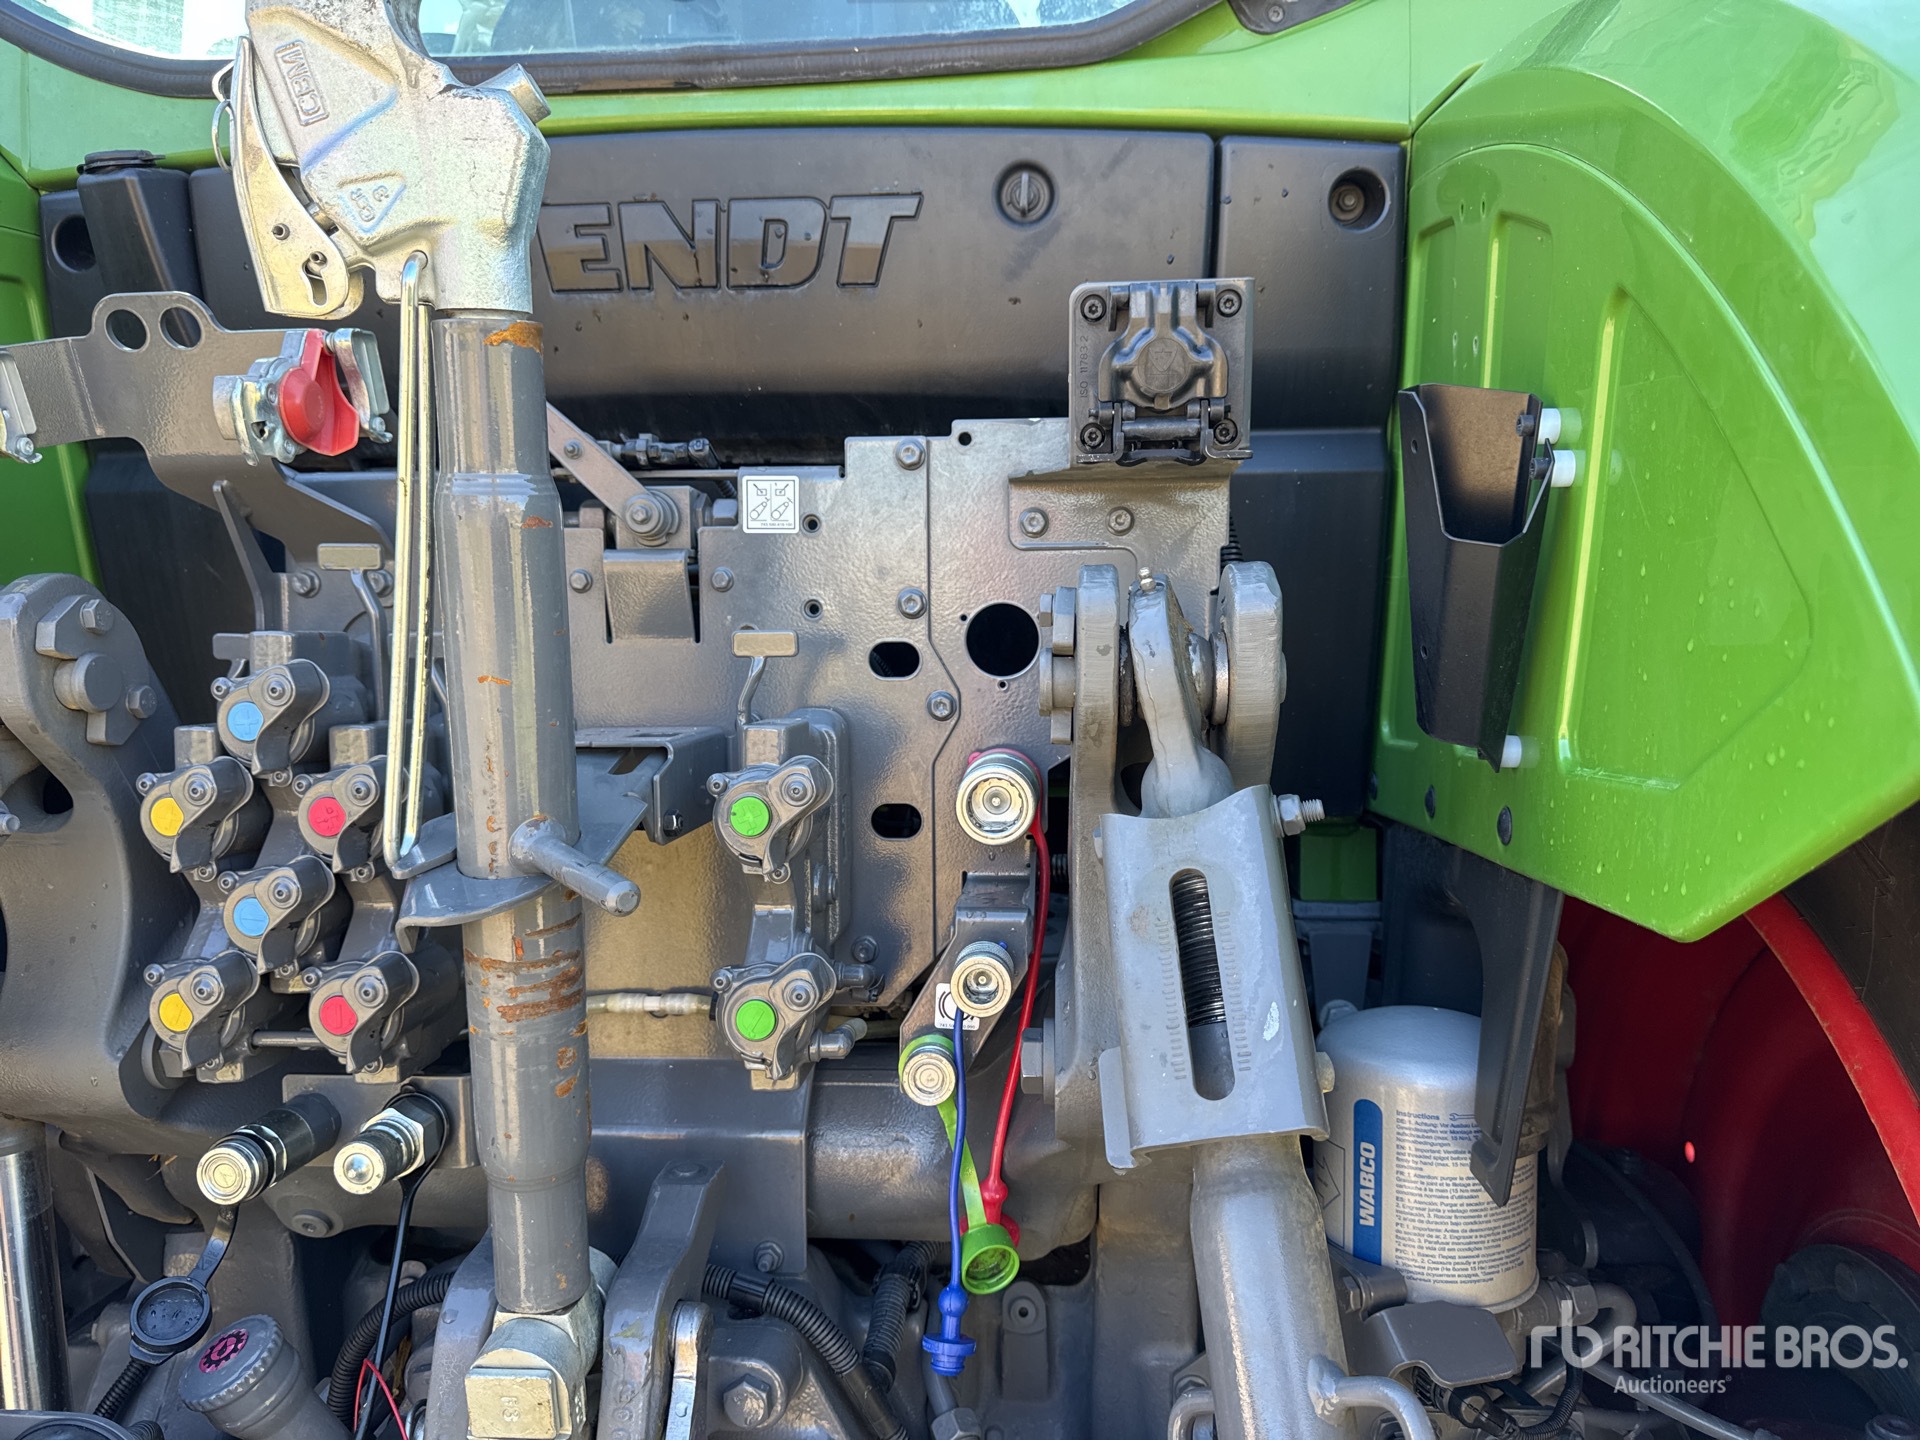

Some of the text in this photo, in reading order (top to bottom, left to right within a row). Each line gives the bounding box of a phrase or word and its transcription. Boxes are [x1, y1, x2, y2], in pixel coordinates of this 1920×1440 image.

[537, 192, 924, 292] ENDT
[1079, 380, 1089, 398] ISO
[1396, 1110, 1440, 1120] Instructions
[1359, 1141, 1376, 1227] WABCO
